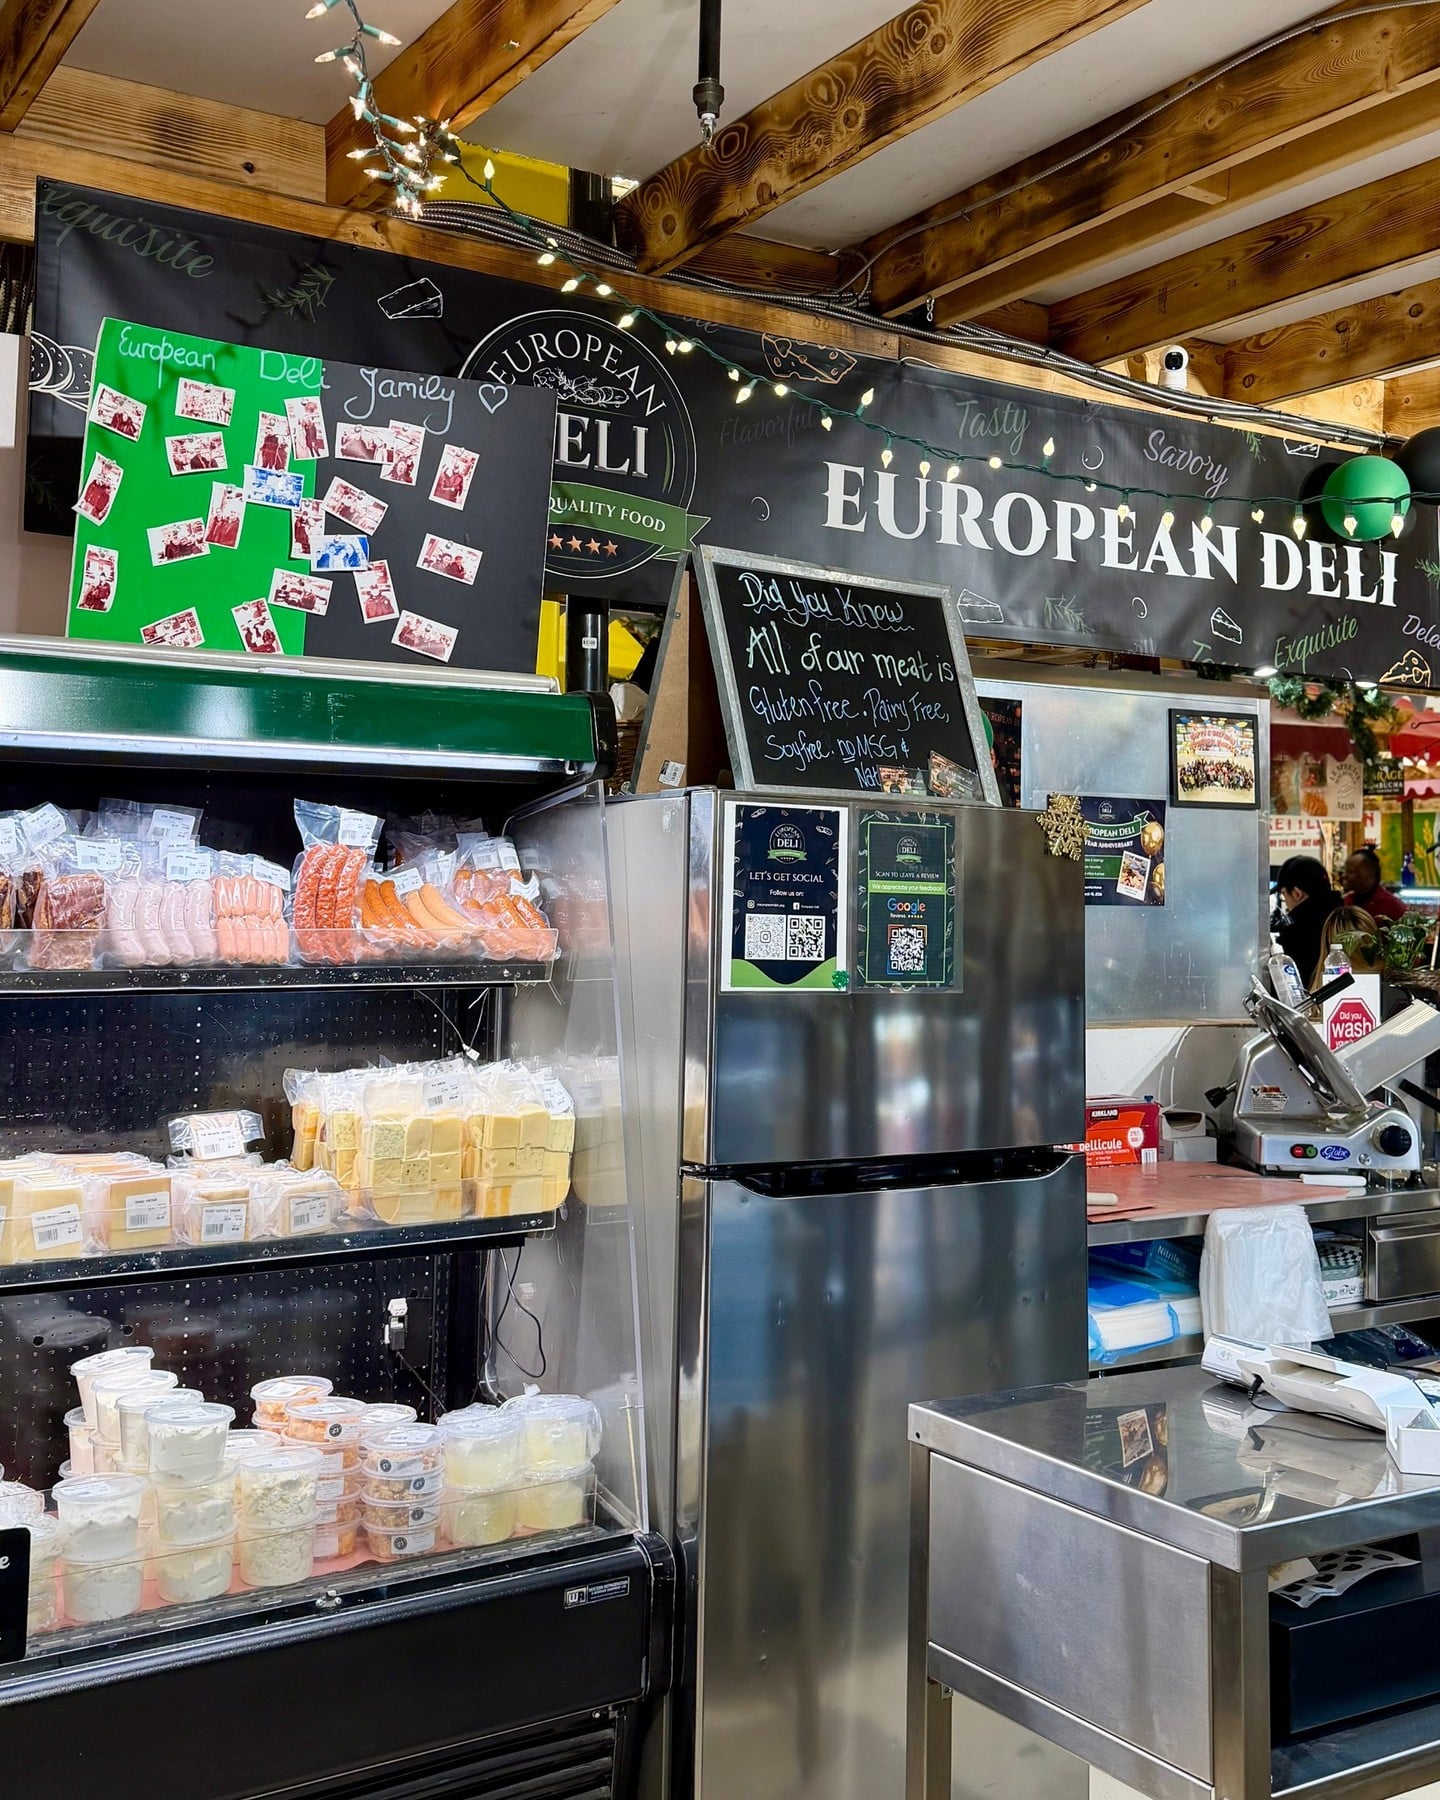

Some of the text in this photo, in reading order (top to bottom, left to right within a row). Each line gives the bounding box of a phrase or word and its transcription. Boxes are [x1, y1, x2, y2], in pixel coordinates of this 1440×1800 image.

[260, 350, 331, 390] Deli
[486, 329, 667, 417] EUROPEAN
[555, 412, 649, 478] ELI
[958, 399, 1031, 455] Tasty
[1143, 428, 1229, 498] Savory
[549, 495, 666, 533] QUALITY FOOD
[822, 461, 1399, 607] EUROPEAN DELI
[738, 573, 787, 608] Did
[836, 588, 904, 624] Know
[746, 620, 791, 676] All
[826, 651, 865, 675] our
[871, 652, 933, 686] meat
[936, 654, 956, 683] is
[1274, 613, 1359, 674] Exquisite
[777, 838, 799, 849] DELI
[1119, 826, 1135, 837] DELI
[749, 870, 824, 883] LET'S GET SOCIAL
[875, 870, 890, 878] SCAN
[891, 870, 899, 878] TO
[887, 897, 926, 915] Google
[1331, 1017, 1372, 1038] wash
[1340, 1011, 1362, 1021] Did you
[1091, 1109, 1118, 1117] KIRKLAND
[1157, 1244, 1180, 1265] Nitrile
